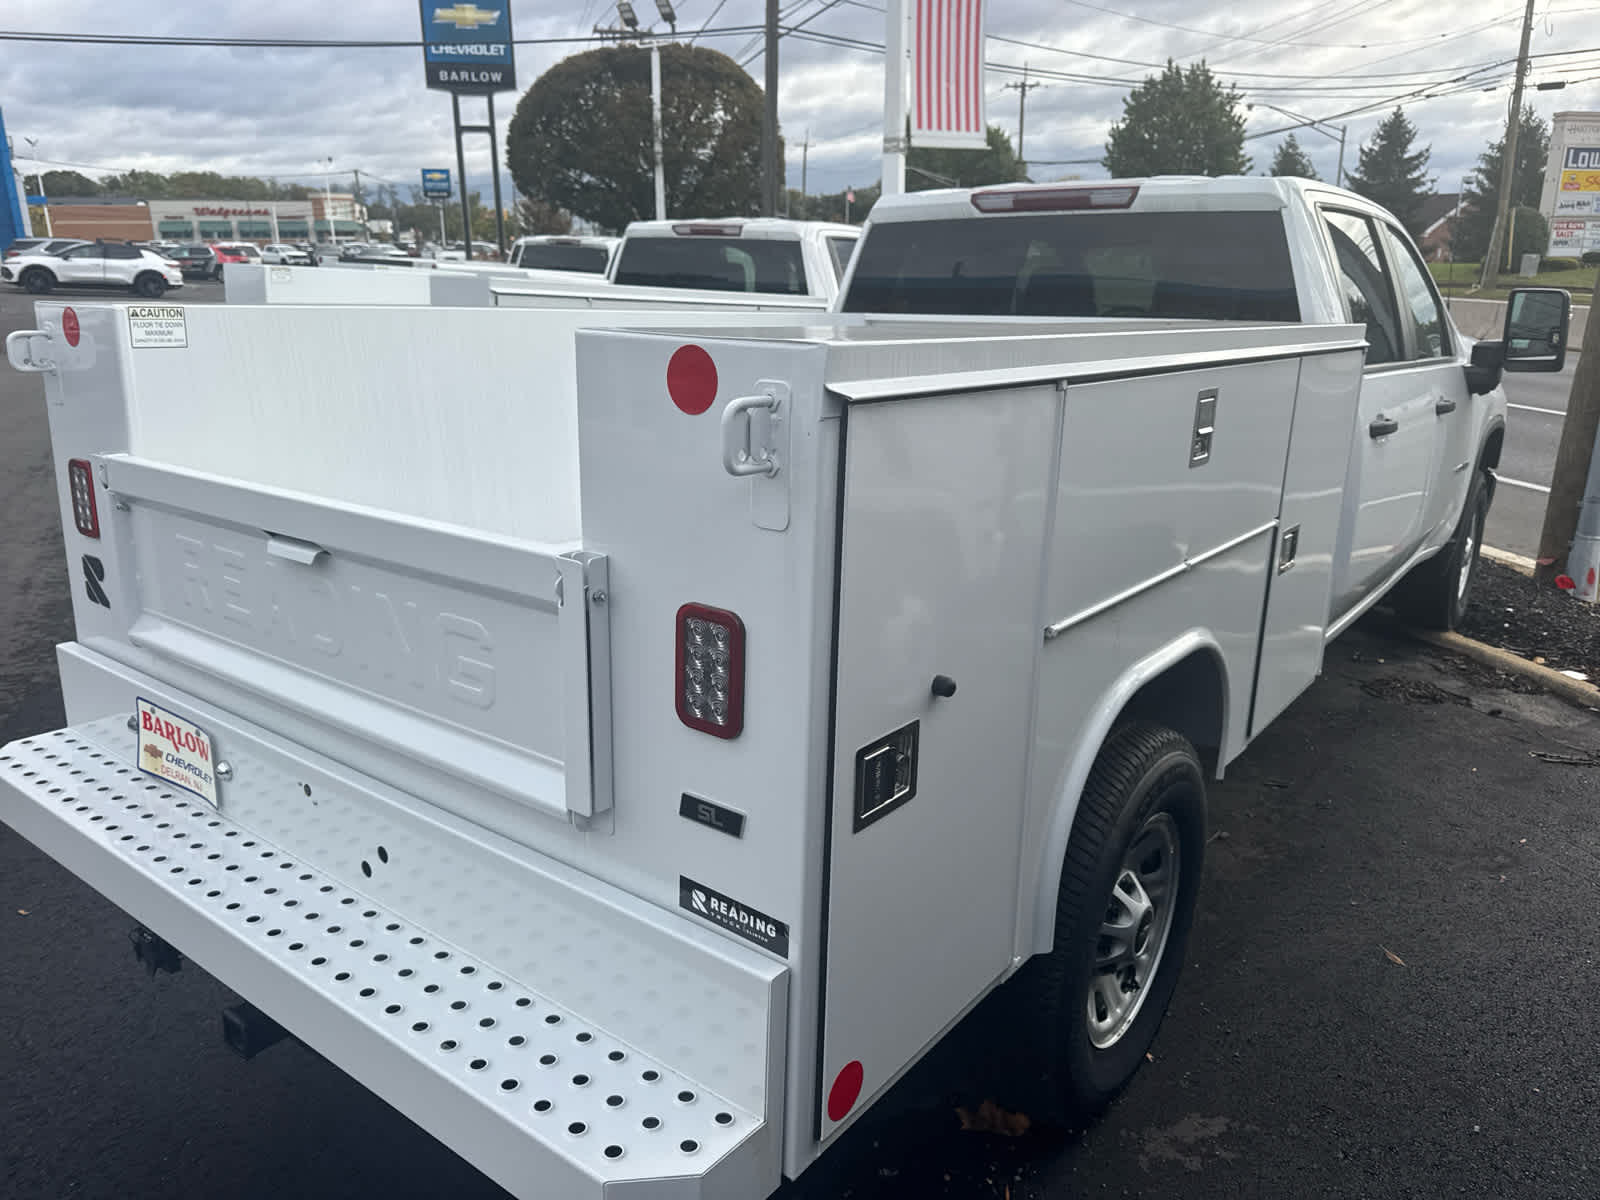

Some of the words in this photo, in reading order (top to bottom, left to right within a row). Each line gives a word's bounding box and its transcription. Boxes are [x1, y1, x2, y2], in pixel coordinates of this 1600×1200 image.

[430, 43, 506, 57] CHEVROLET
[438, 69, 503, 83] BARLOW
[193, 206, 270, 219] Walgreens
[139, 308, 183, 318] CAUTION
[141, 710, 208, 761] BARLOW
[165, 752, 212, 785] CHEVROLET
[697, 803, 724, 827] SL
[710, 896, 777, 939] READING
